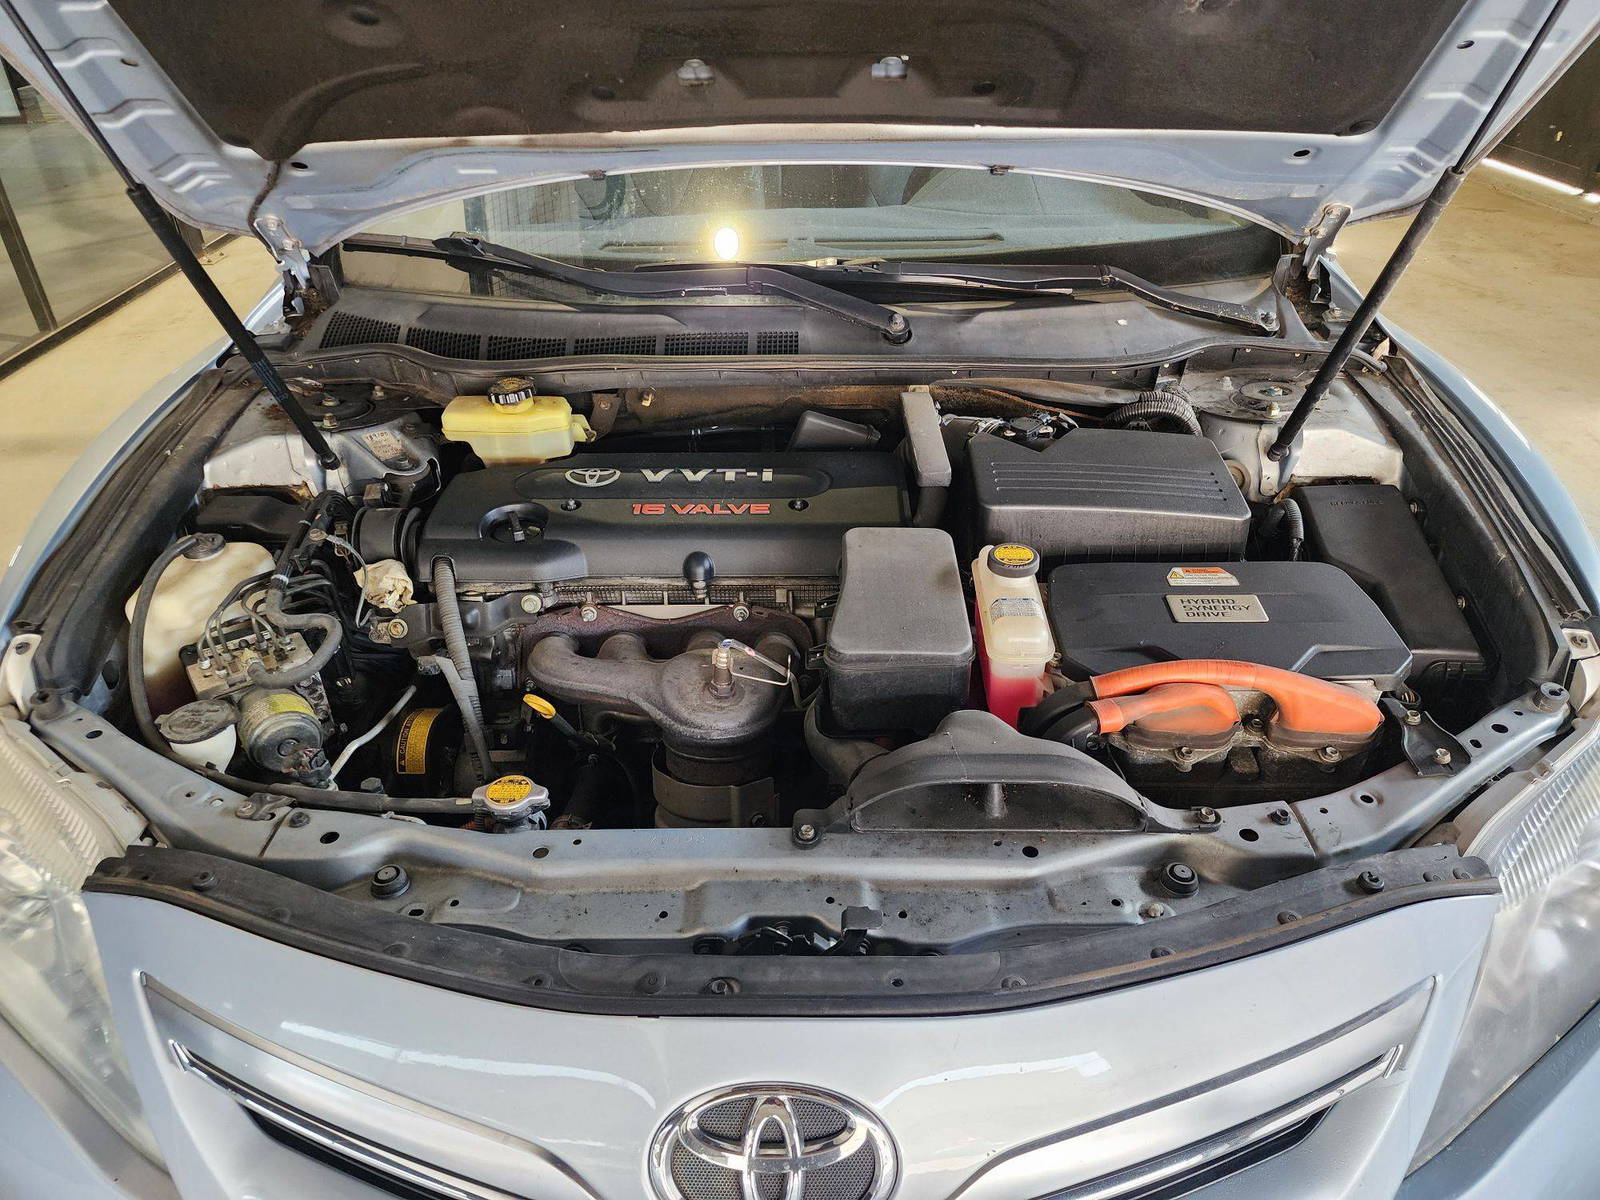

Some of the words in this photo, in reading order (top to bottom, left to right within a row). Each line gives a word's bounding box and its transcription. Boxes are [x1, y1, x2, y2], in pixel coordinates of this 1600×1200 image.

[640, 468, 773, 482] VVT-i
[632, 503, 666, 515] 16
[671, 503, 771, 515] VALVE
